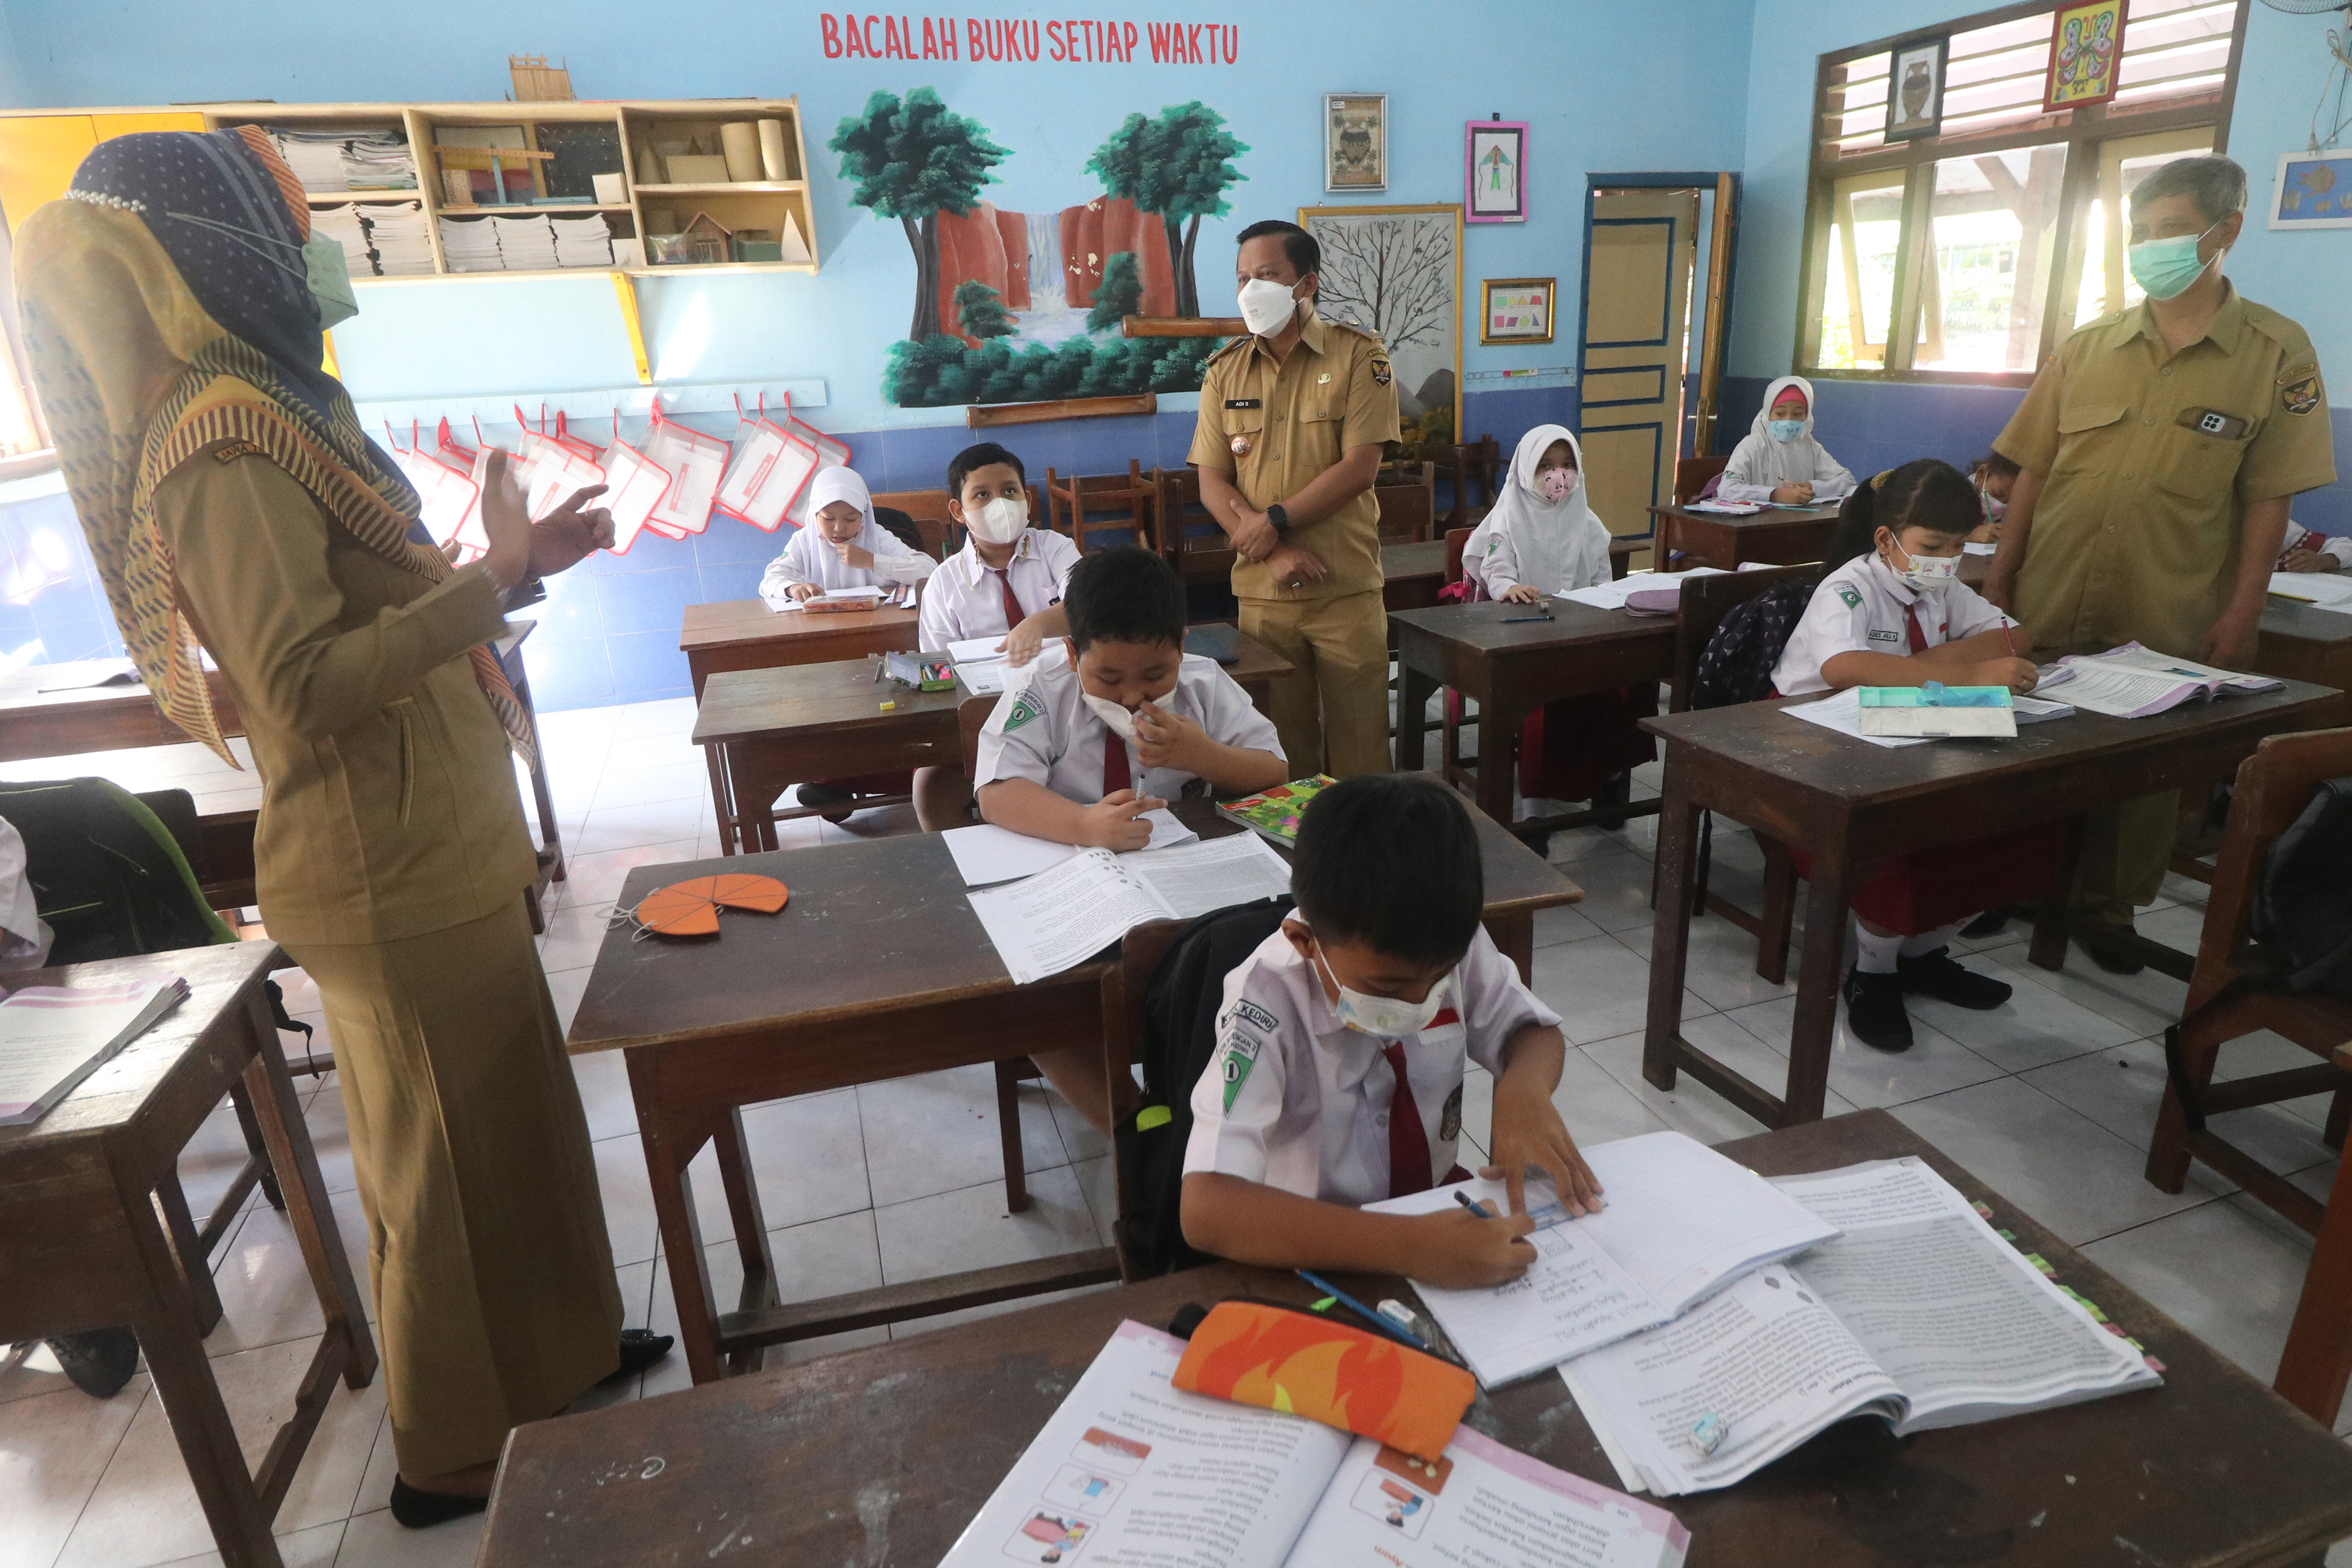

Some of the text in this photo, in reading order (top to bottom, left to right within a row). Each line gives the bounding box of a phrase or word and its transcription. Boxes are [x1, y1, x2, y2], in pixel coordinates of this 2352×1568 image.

[821, 14, 1238, 65] BACALAH BUKU SETIAP WAKTU
[750, 460, 769, 490] PORTOFOLIO
[673, 470, 686, 503] PORTOFOLIO
[1241, 1004, 1273, 1028] KEDIRI
[1228, 1063, 1234, 1078] 1
[1475, 1486, 1509, 1506] mudah
[1503, 1510, 1525, 1524] atau
[1509, 1502, 1552, 1526] kandang
[1458, 1514, 1552, 1563] kandang sederhana
[1553, 1521, 1576, 1536] agar
[1559, 1537, 1579, 1549] alas
[1576, 1532, 1606, 1549] koran
[1581, 1546, 1603, 1559] Beri
